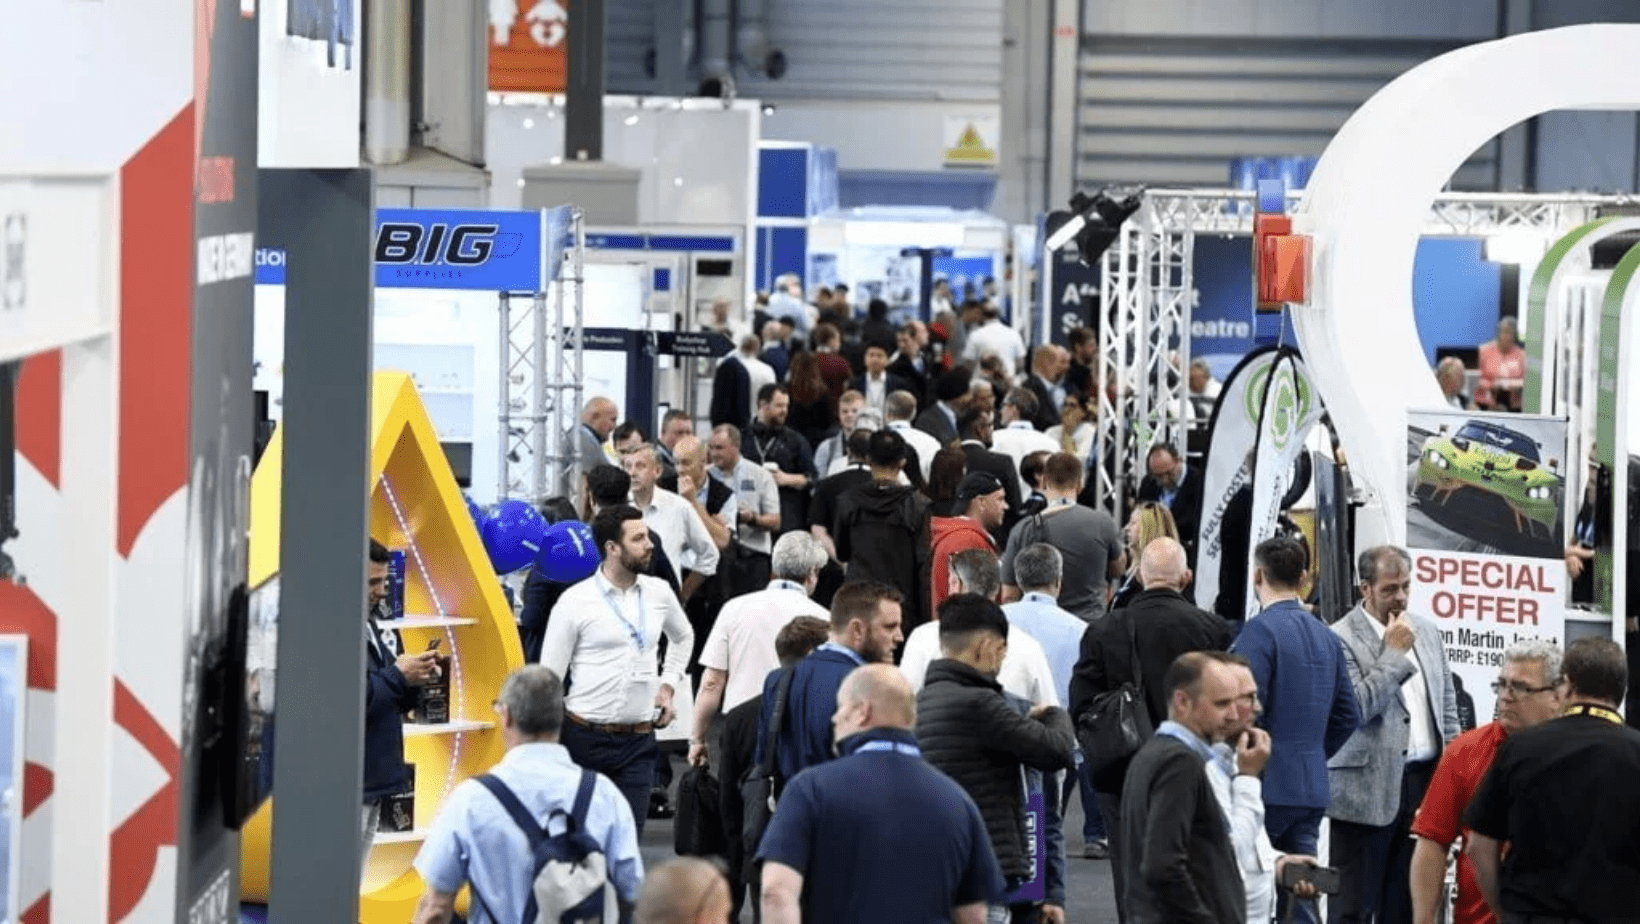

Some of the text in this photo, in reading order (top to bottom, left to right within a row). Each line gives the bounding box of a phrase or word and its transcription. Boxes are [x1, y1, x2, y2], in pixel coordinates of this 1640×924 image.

[1416, 556, 1556, 593] SPECIAL
[1432, 591, 1539, 626] OFFER
[1458, 628, 1505, 649] Martin
